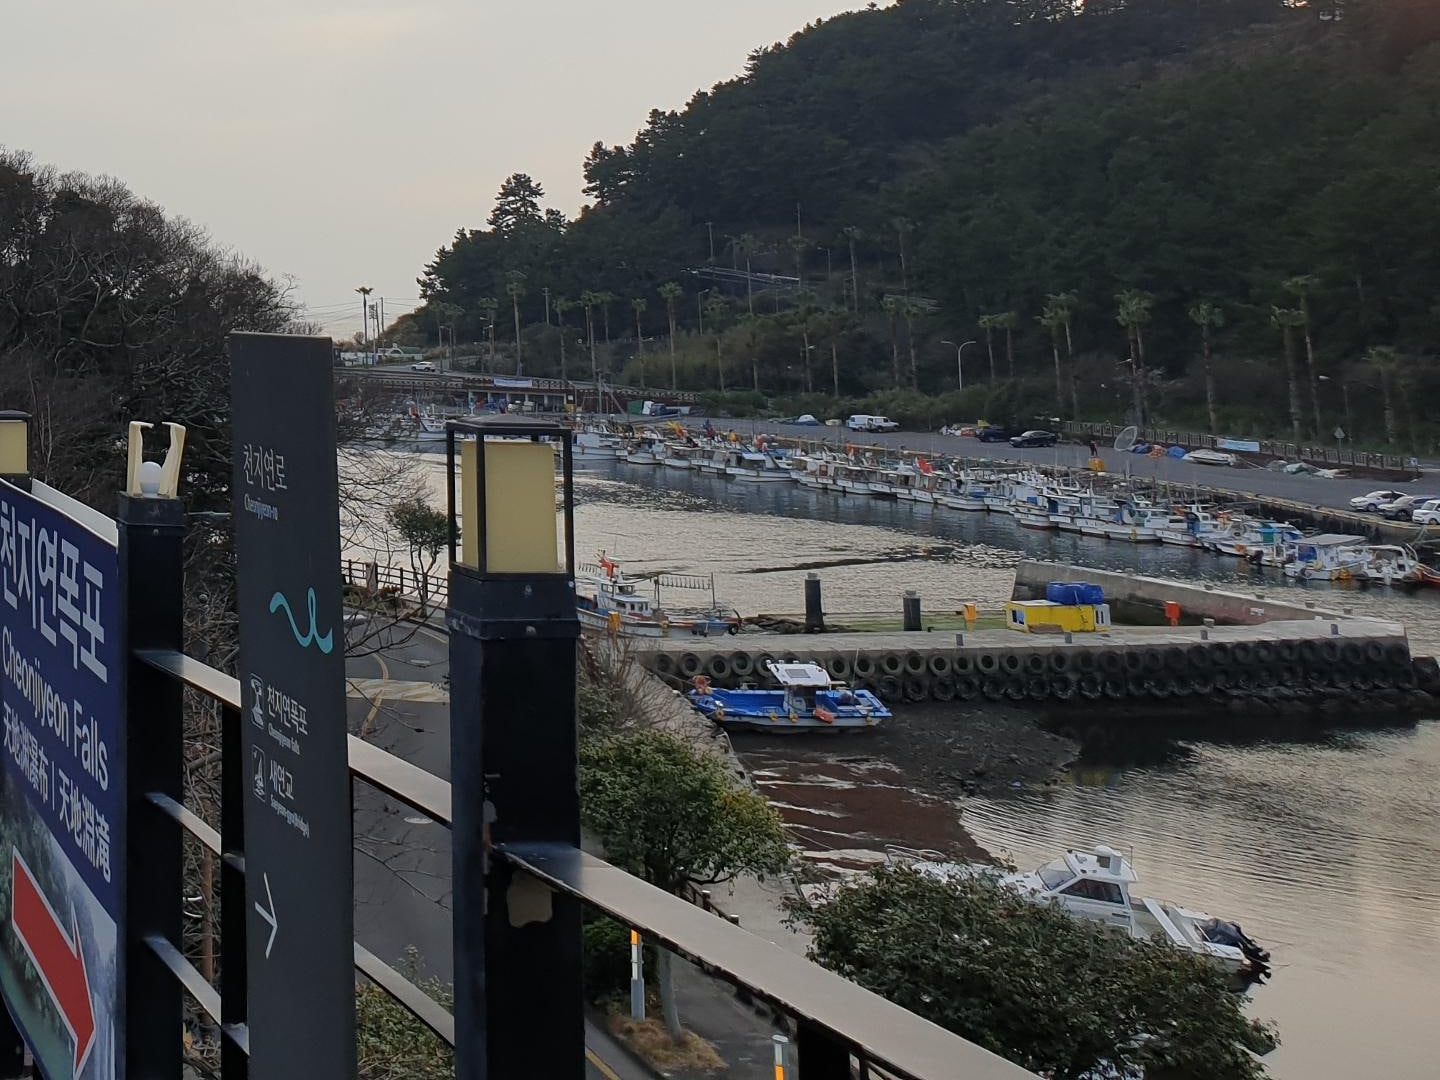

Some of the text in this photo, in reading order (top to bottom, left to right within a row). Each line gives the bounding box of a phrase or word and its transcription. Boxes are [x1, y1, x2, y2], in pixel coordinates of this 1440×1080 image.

[243, 443, 288, 491] 천지연로
[0, 500, 108, 684] 천지연폭포
[2, 625, 109, 792] Cheonjiyeon Falls
[267, 684, 308, 735] 천지연폭포
